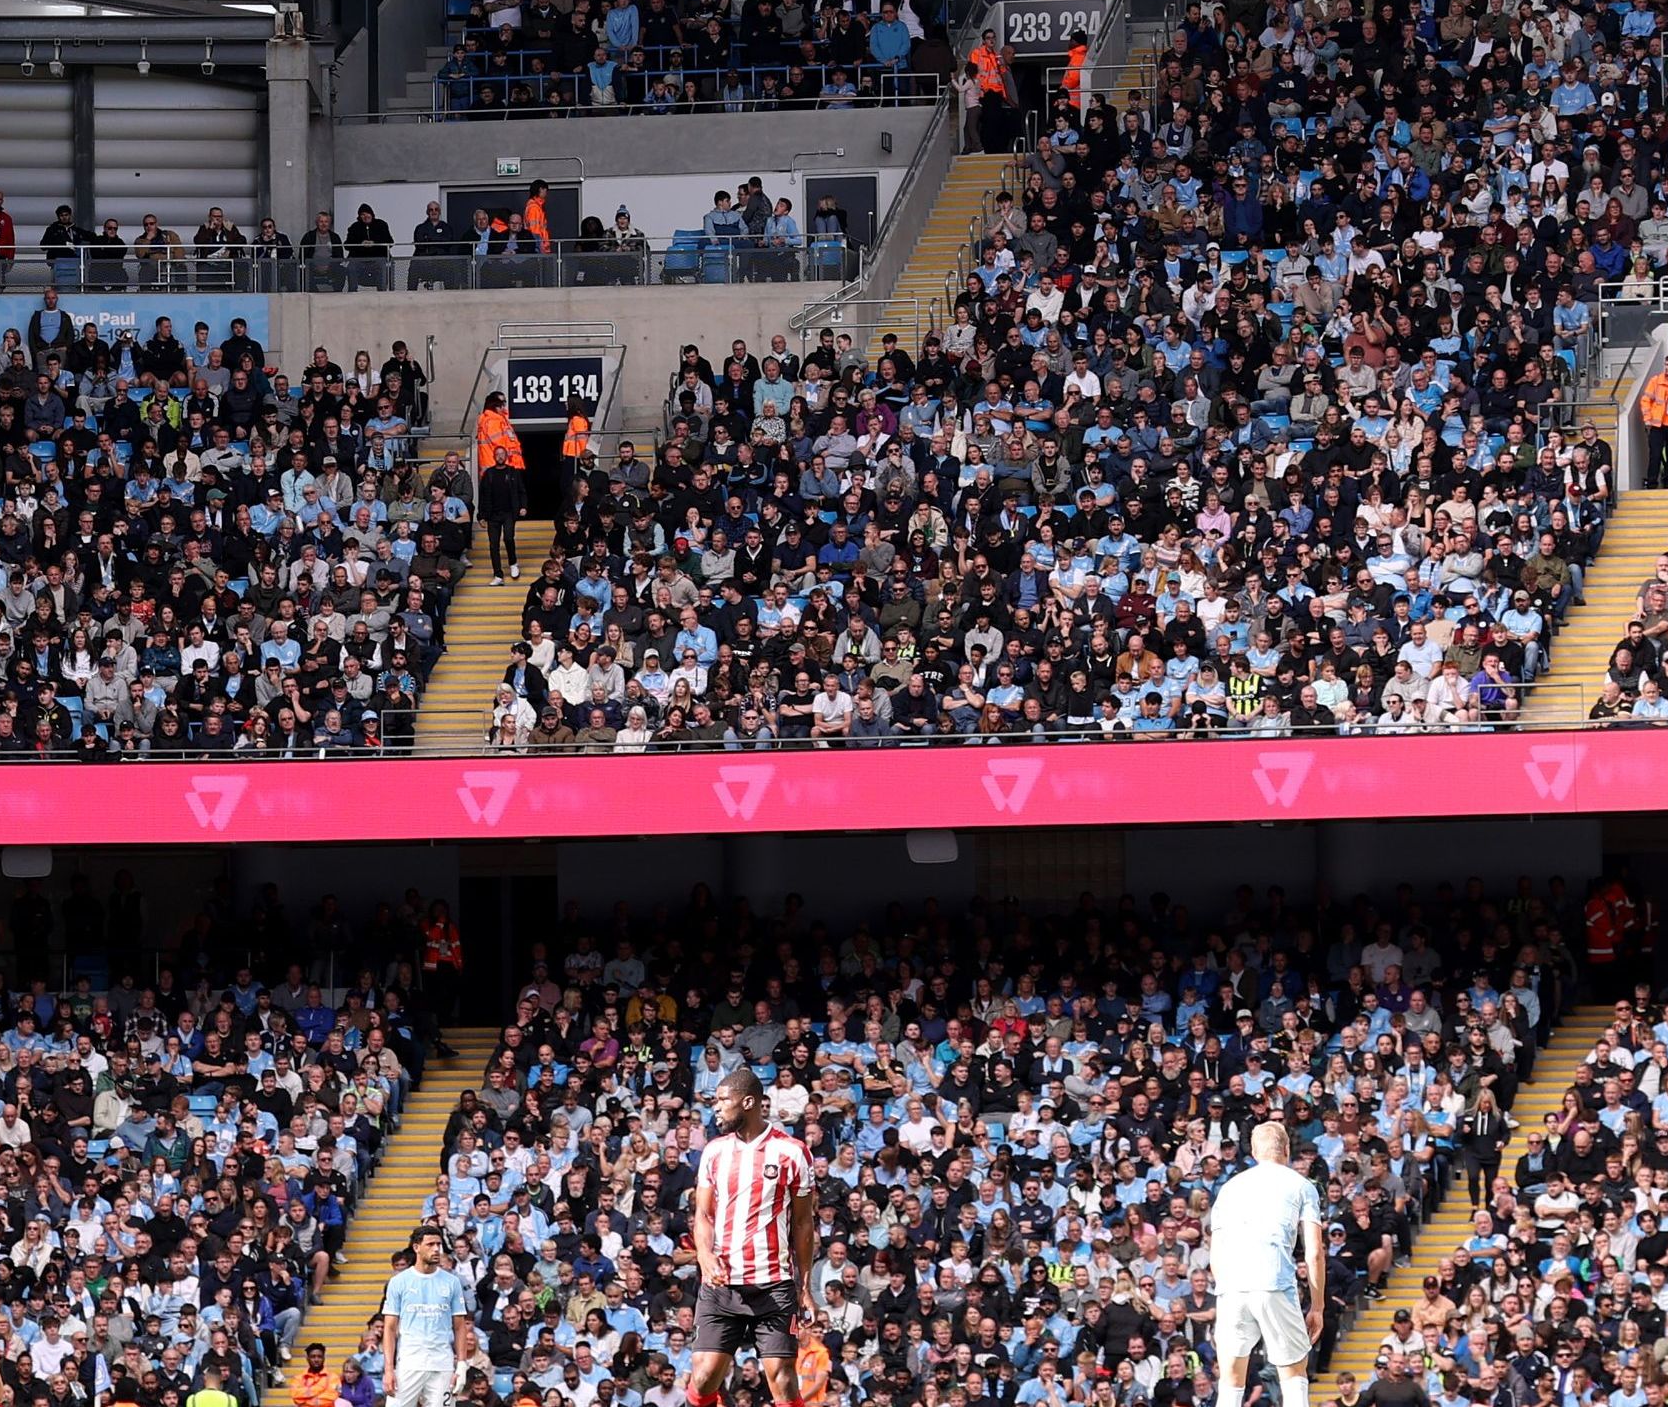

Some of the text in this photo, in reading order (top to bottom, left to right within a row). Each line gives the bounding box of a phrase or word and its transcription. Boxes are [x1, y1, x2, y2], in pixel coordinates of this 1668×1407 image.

[1009, 10, 1101, 43] 233 234
[100, 311, 136, 326] Paul
[513, 374, 599, 403] 133 134
